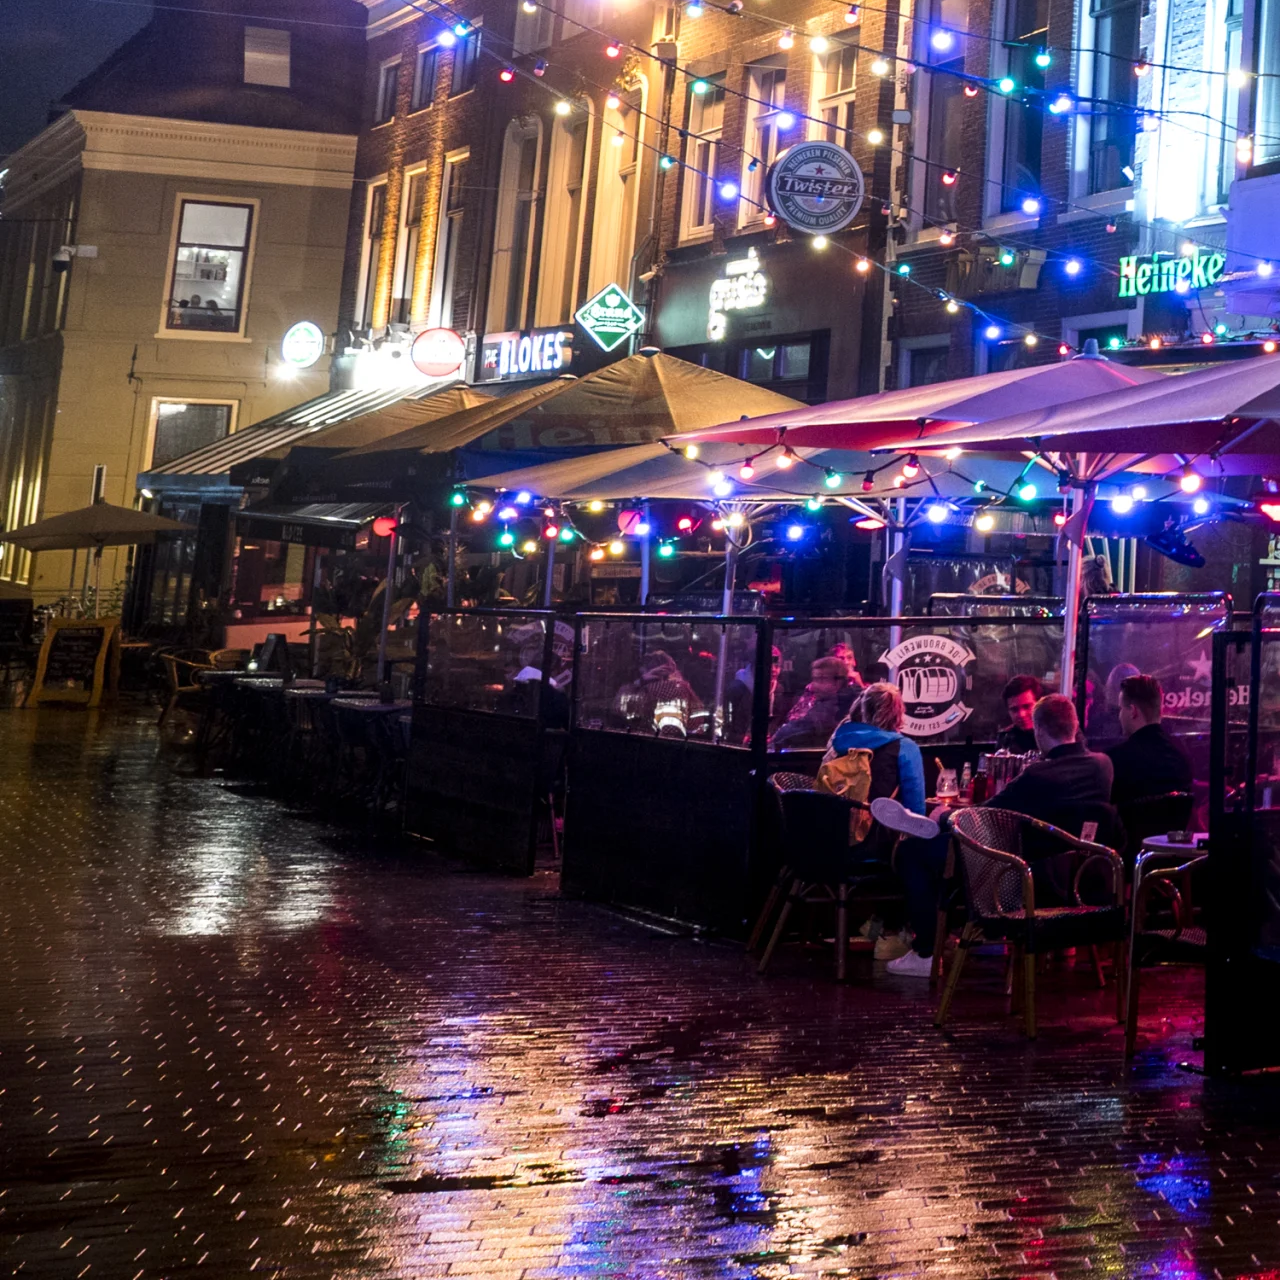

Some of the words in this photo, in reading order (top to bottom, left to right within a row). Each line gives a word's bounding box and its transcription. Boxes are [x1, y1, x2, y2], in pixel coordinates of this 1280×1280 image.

[788, 149, 820, 169] HEINEKEN
[822, 150, 851, 174] PILSENER
[784, 177, 853, 195] Twister
[785, 201, 817, 225] PREMIUM
[818, 206, 848, 225] QUALITY
[1119, 251, 1226, 297] Heineke
[499, 333, 565, 375] BLOKES
